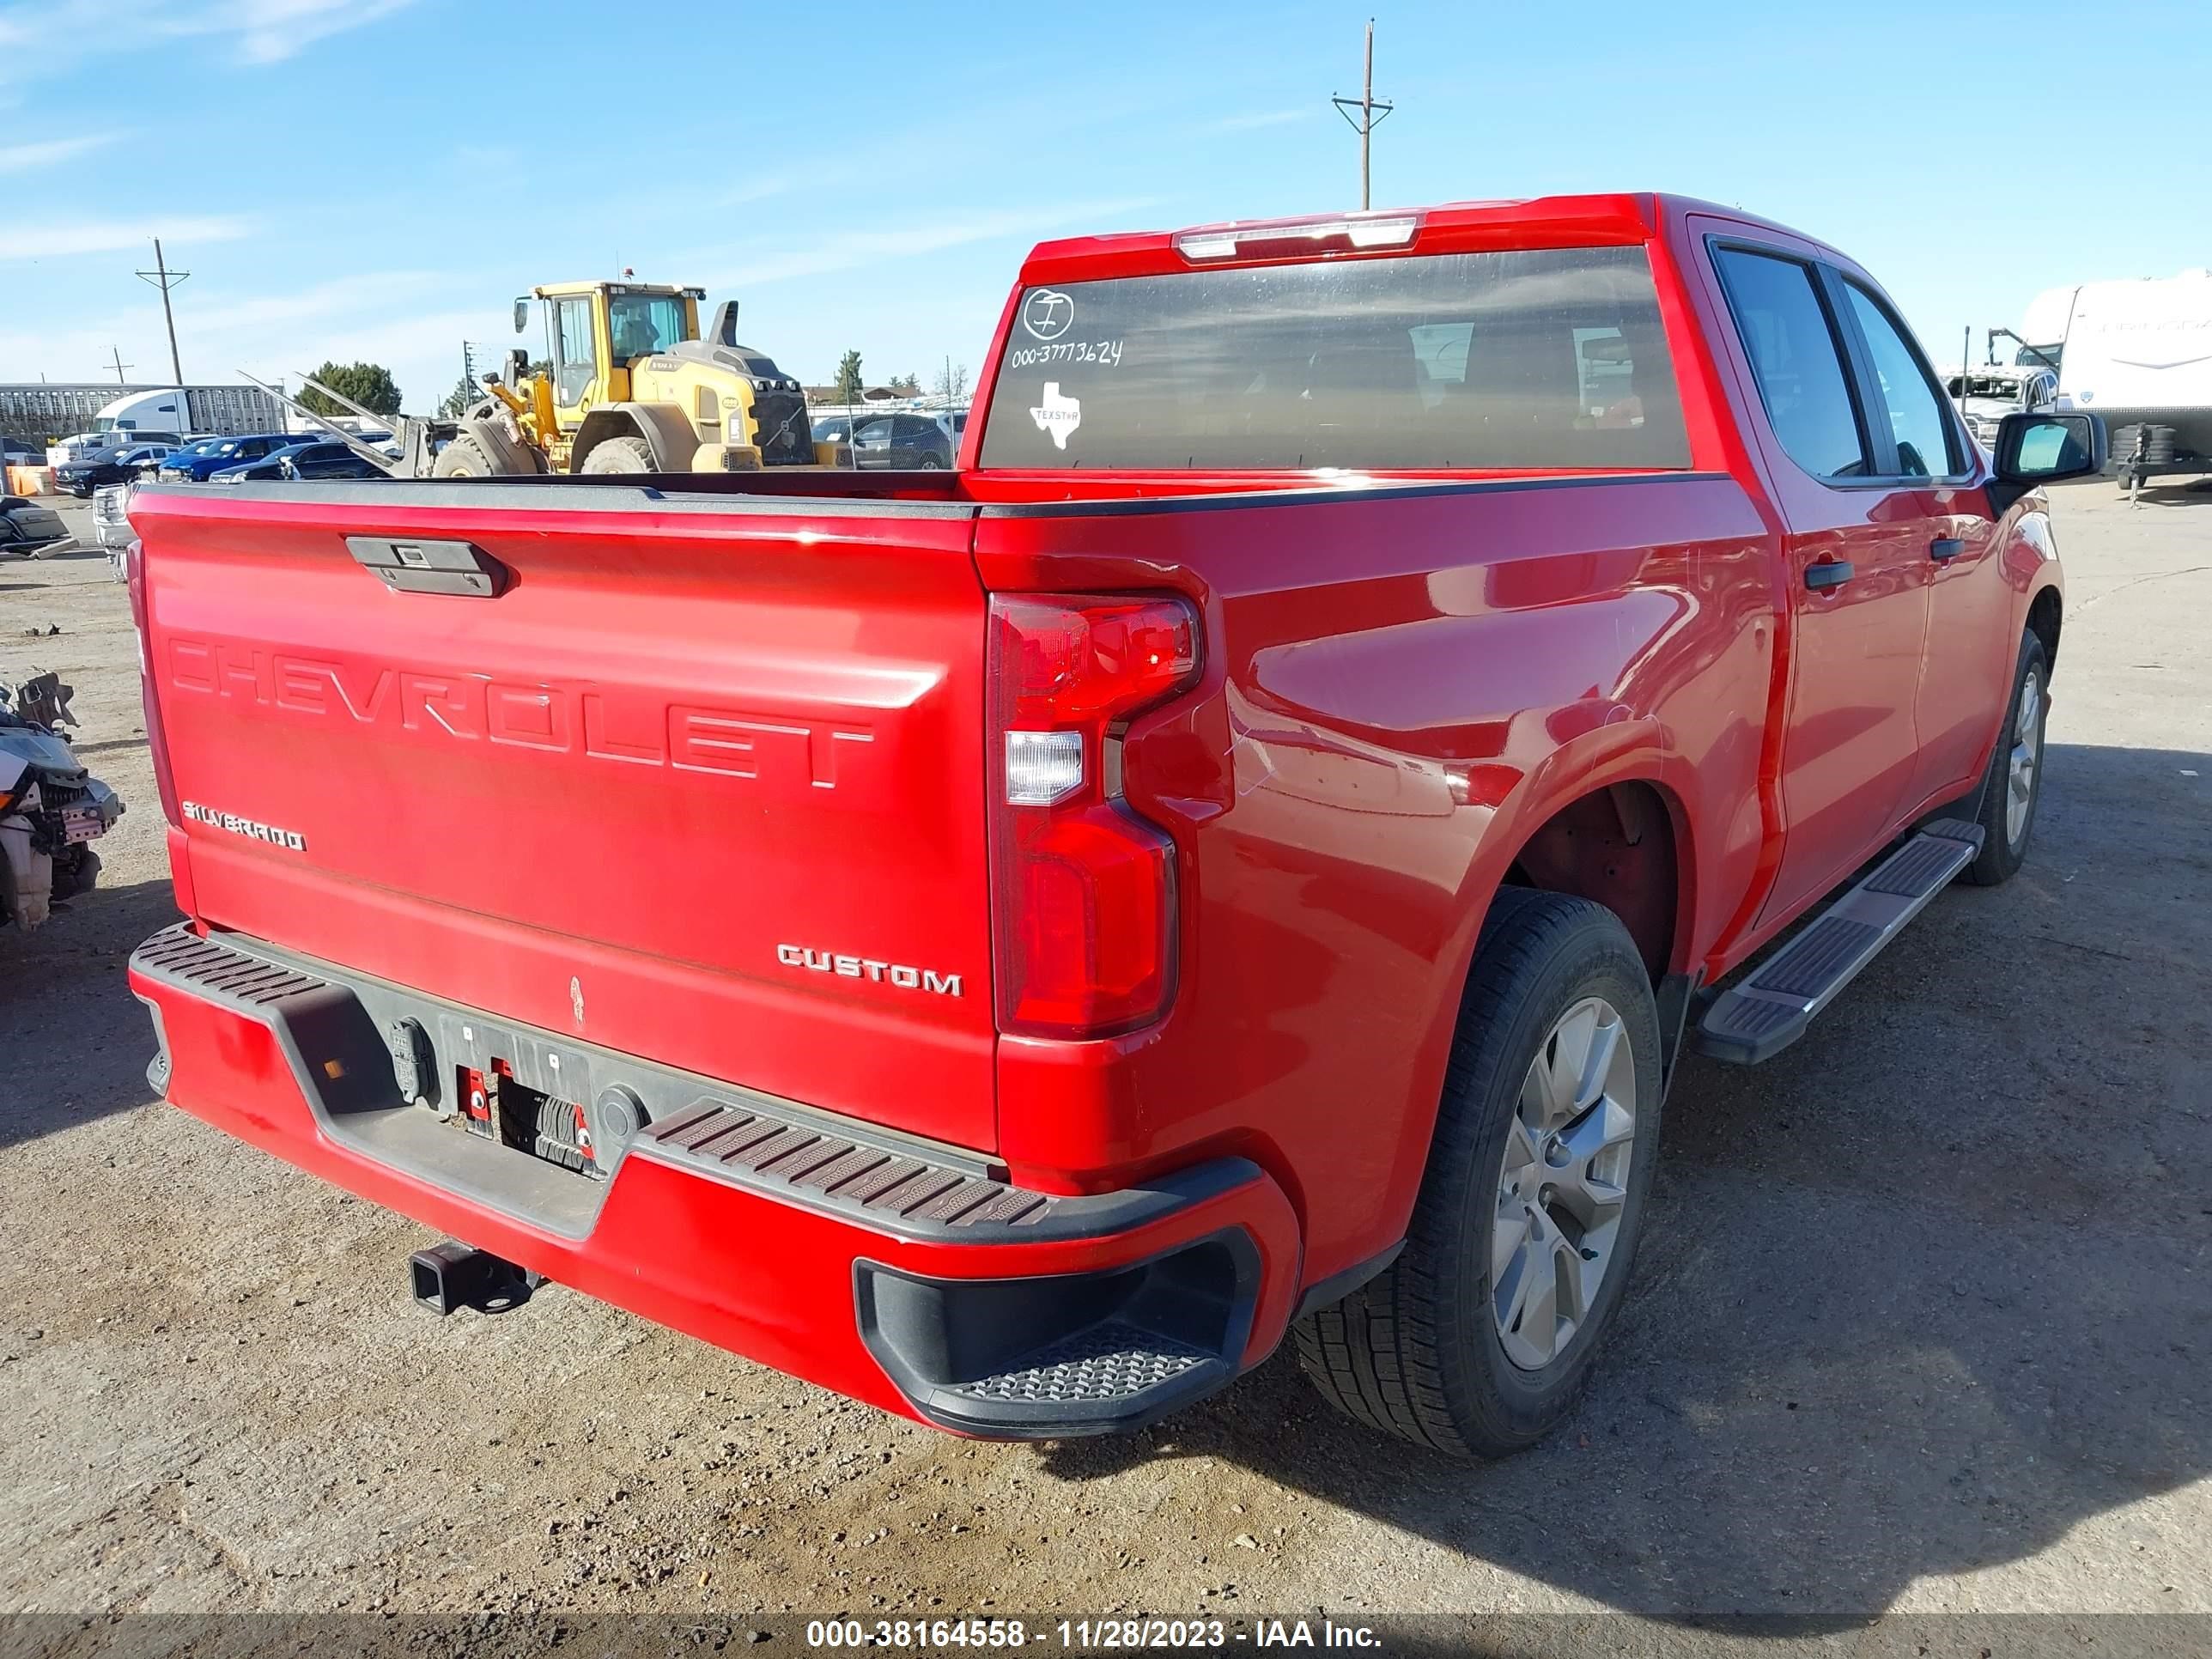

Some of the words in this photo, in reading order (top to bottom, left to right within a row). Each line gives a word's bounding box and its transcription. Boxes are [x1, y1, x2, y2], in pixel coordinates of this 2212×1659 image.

[1012, 340, 1123, 368] 000-37773624
[168, 637, 875, 789] CHEVROLET
[182, 800, 307, 852] SILVERADO
[777, 943, 963, 997] CUSTOM
